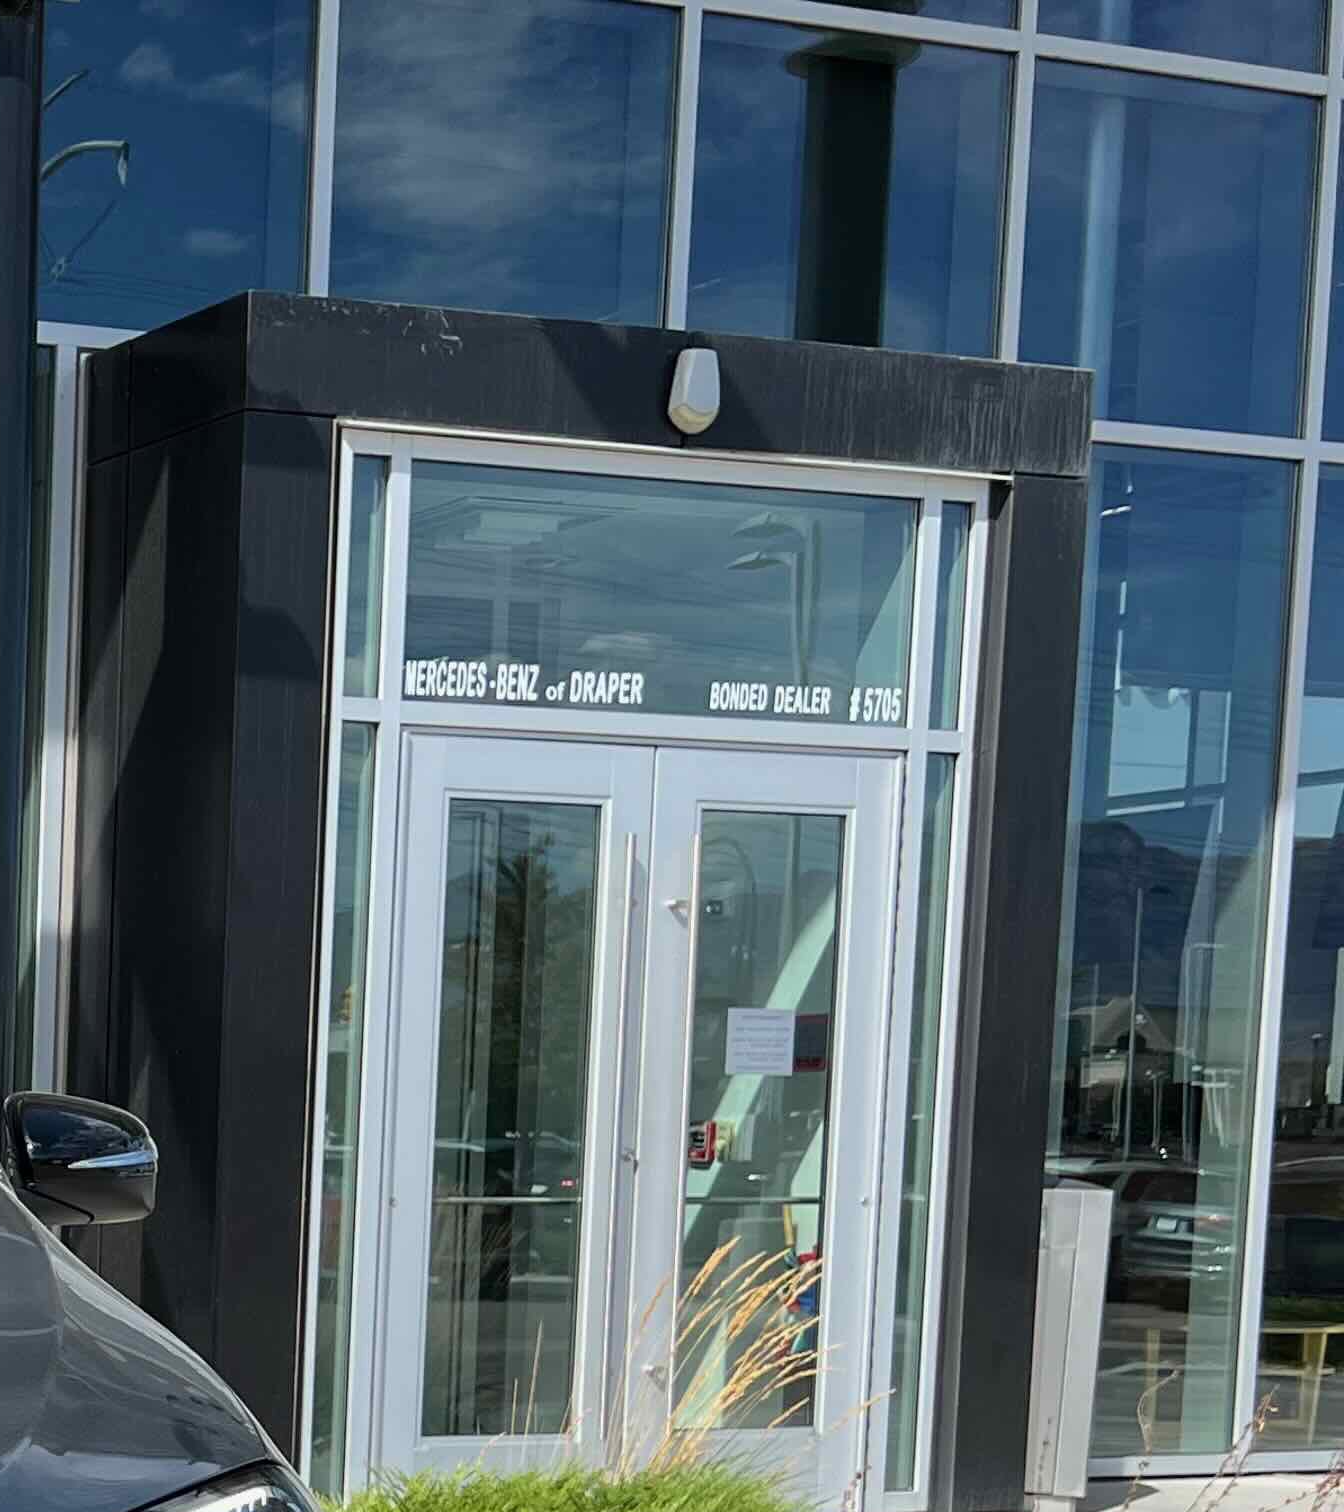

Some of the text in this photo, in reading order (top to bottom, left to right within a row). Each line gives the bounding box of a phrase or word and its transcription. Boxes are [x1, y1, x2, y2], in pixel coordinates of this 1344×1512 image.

[404, 660, 644, 704] MERCEDES-BENZ of DRAPER
[709, 682, 768, 712] BONDED
[773, 686, 831, 715] DEALER
